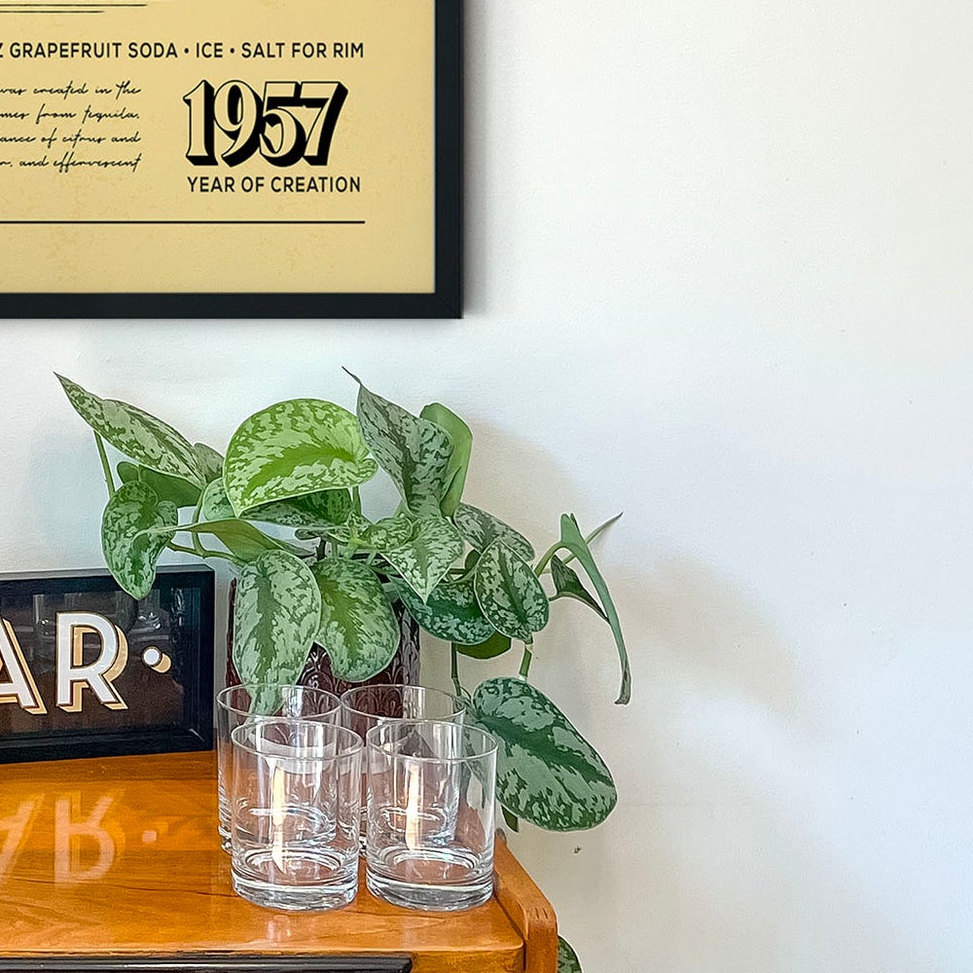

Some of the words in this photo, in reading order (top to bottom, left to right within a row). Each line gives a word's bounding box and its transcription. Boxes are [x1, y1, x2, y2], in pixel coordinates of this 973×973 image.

[9, 42, 123, 59] GRAPEFRUIT
[128, 42, 178, 59] SODA
[196, 42, 224, 59] ICE
[241, 42, 286, 59] SALT
[291, 42, 327, 59] FOR
[333, 42, 365, 59] RIM
[115, 80, 142, 100] the
[183, 80, 349, 168] 1957
[40, 127, 58, 149] of
[110, 131, 142, 143] and
[18, 155, 50, 167] and
[186, 176, 236, 193] YEAR
[241, 176, 265, 193] OF
[270, 176, 361, 193] CREATION
